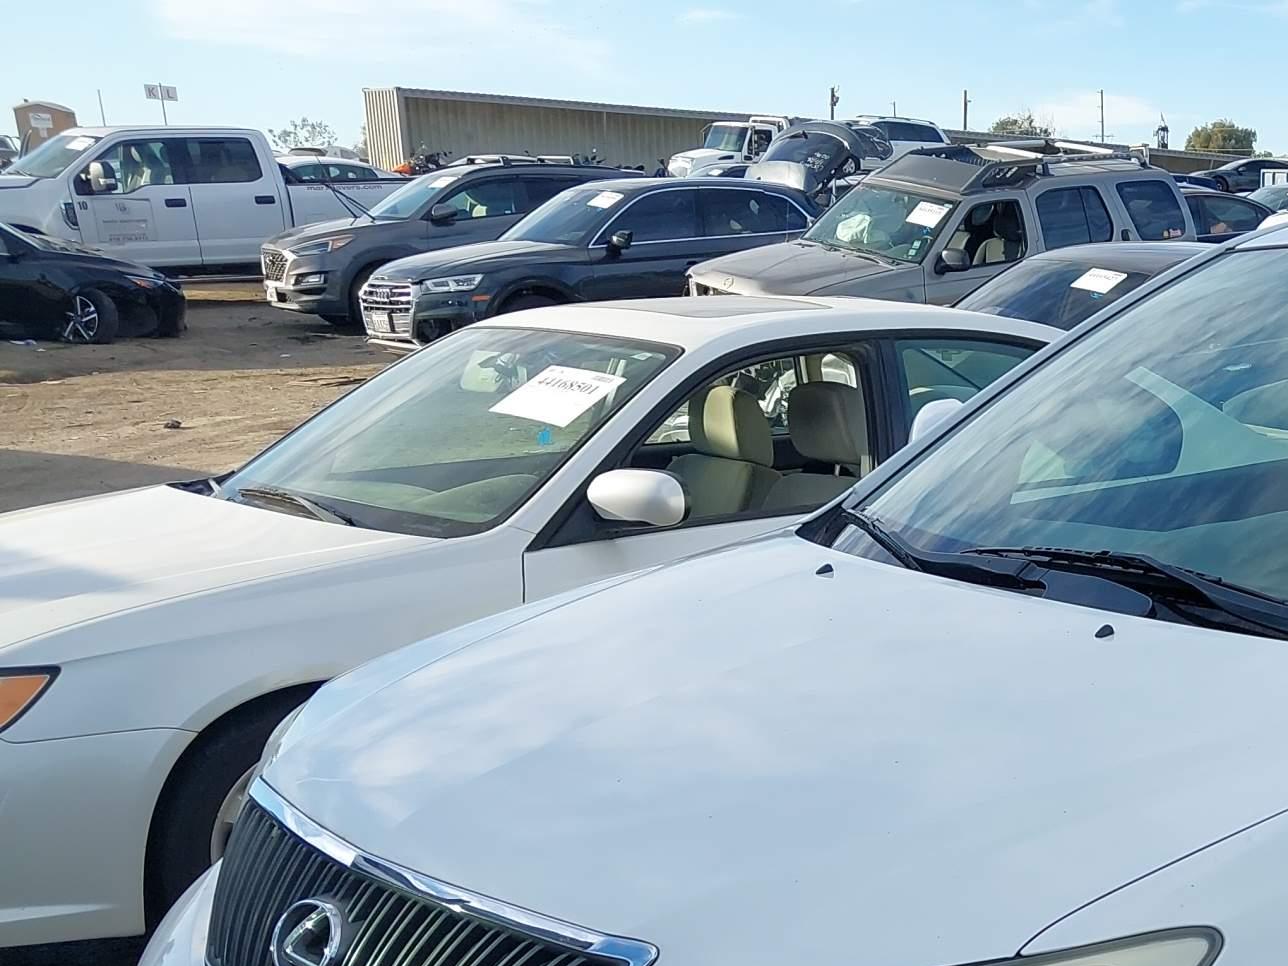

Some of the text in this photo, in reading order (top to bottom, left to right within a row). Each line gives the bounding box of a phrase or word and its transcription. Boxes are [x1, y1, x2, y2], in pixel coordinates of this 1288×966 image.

[147, 87, 156, 97] K
[166, 89, 176, 98] L
[78, 201, 88, 210] 10
[537, 377, 600, 395] 44168501
